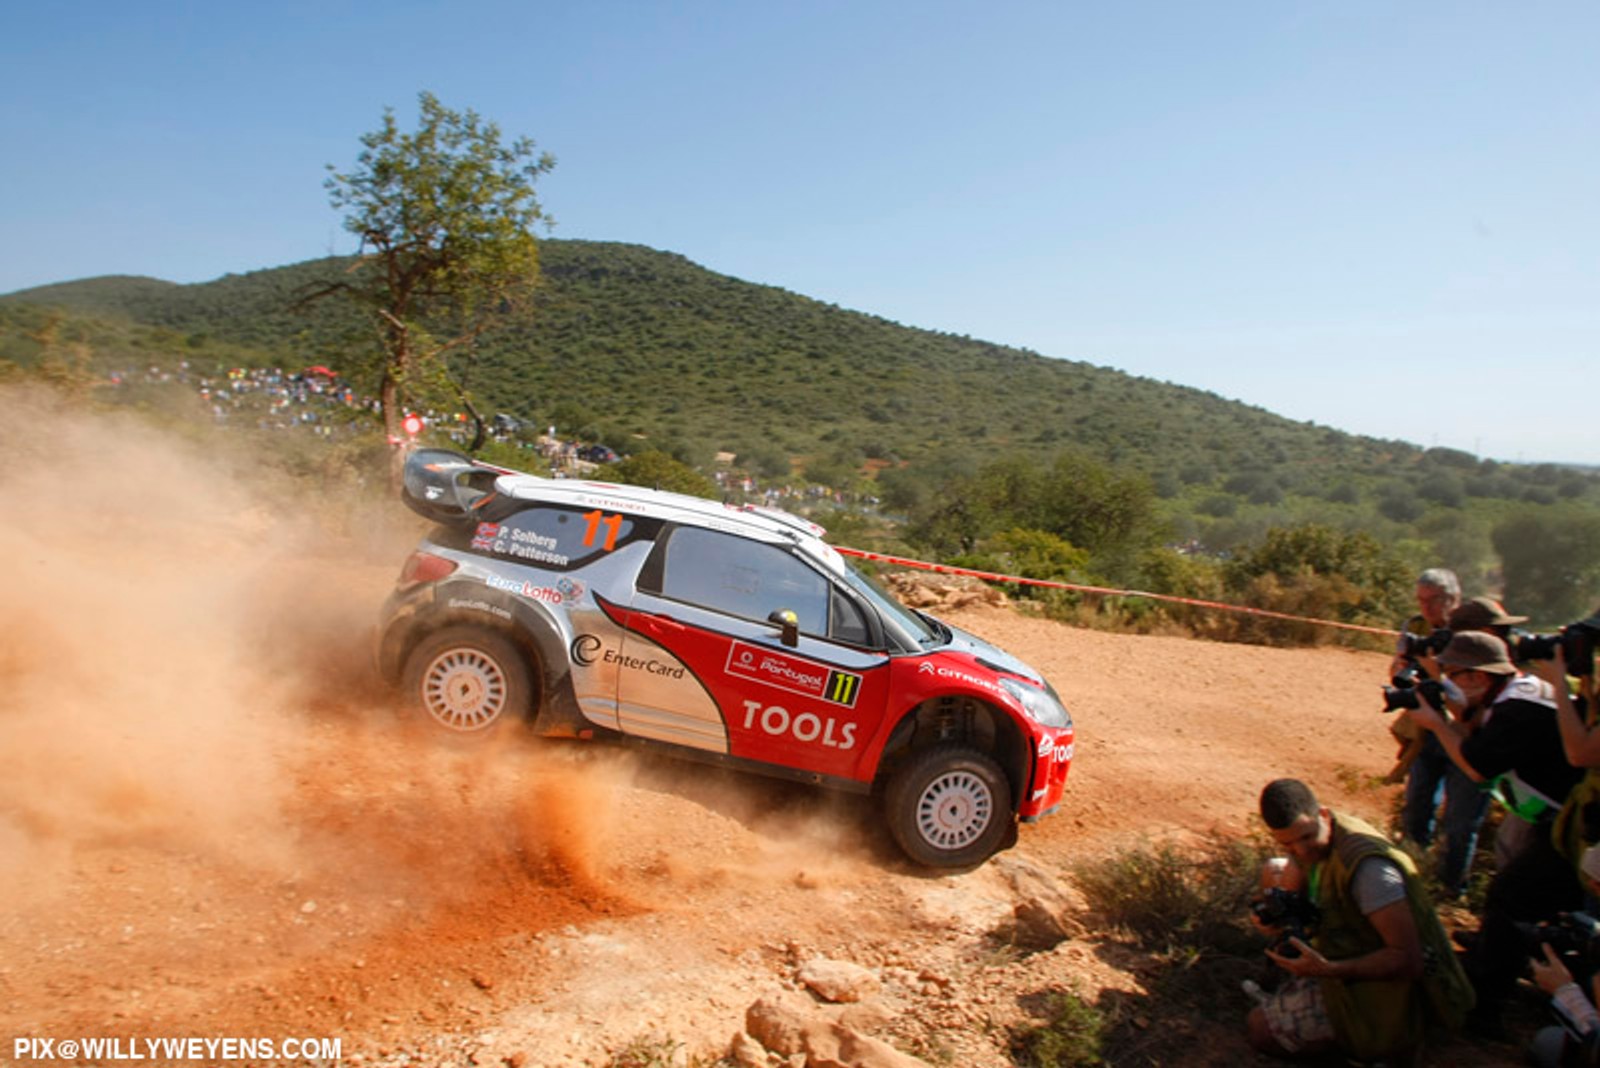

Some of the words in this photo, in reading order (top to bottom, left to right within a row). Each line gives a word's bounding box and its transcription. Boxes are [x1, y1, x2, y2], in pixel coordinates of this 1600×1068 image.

[498, 526, 508, 538] P.
[511, 527, 558, 550] Solberg
[582, 510, 623, 552] 11
[494, 540, 506, 553] C.
[509, 543, 570, 567] Patterson
[603, 649, 685, 680] EnterCard
[760, 661, 822, 687] Portugal
[836, 673, 855, 704] 11
[743, 700, 857, 750] TOOLS
